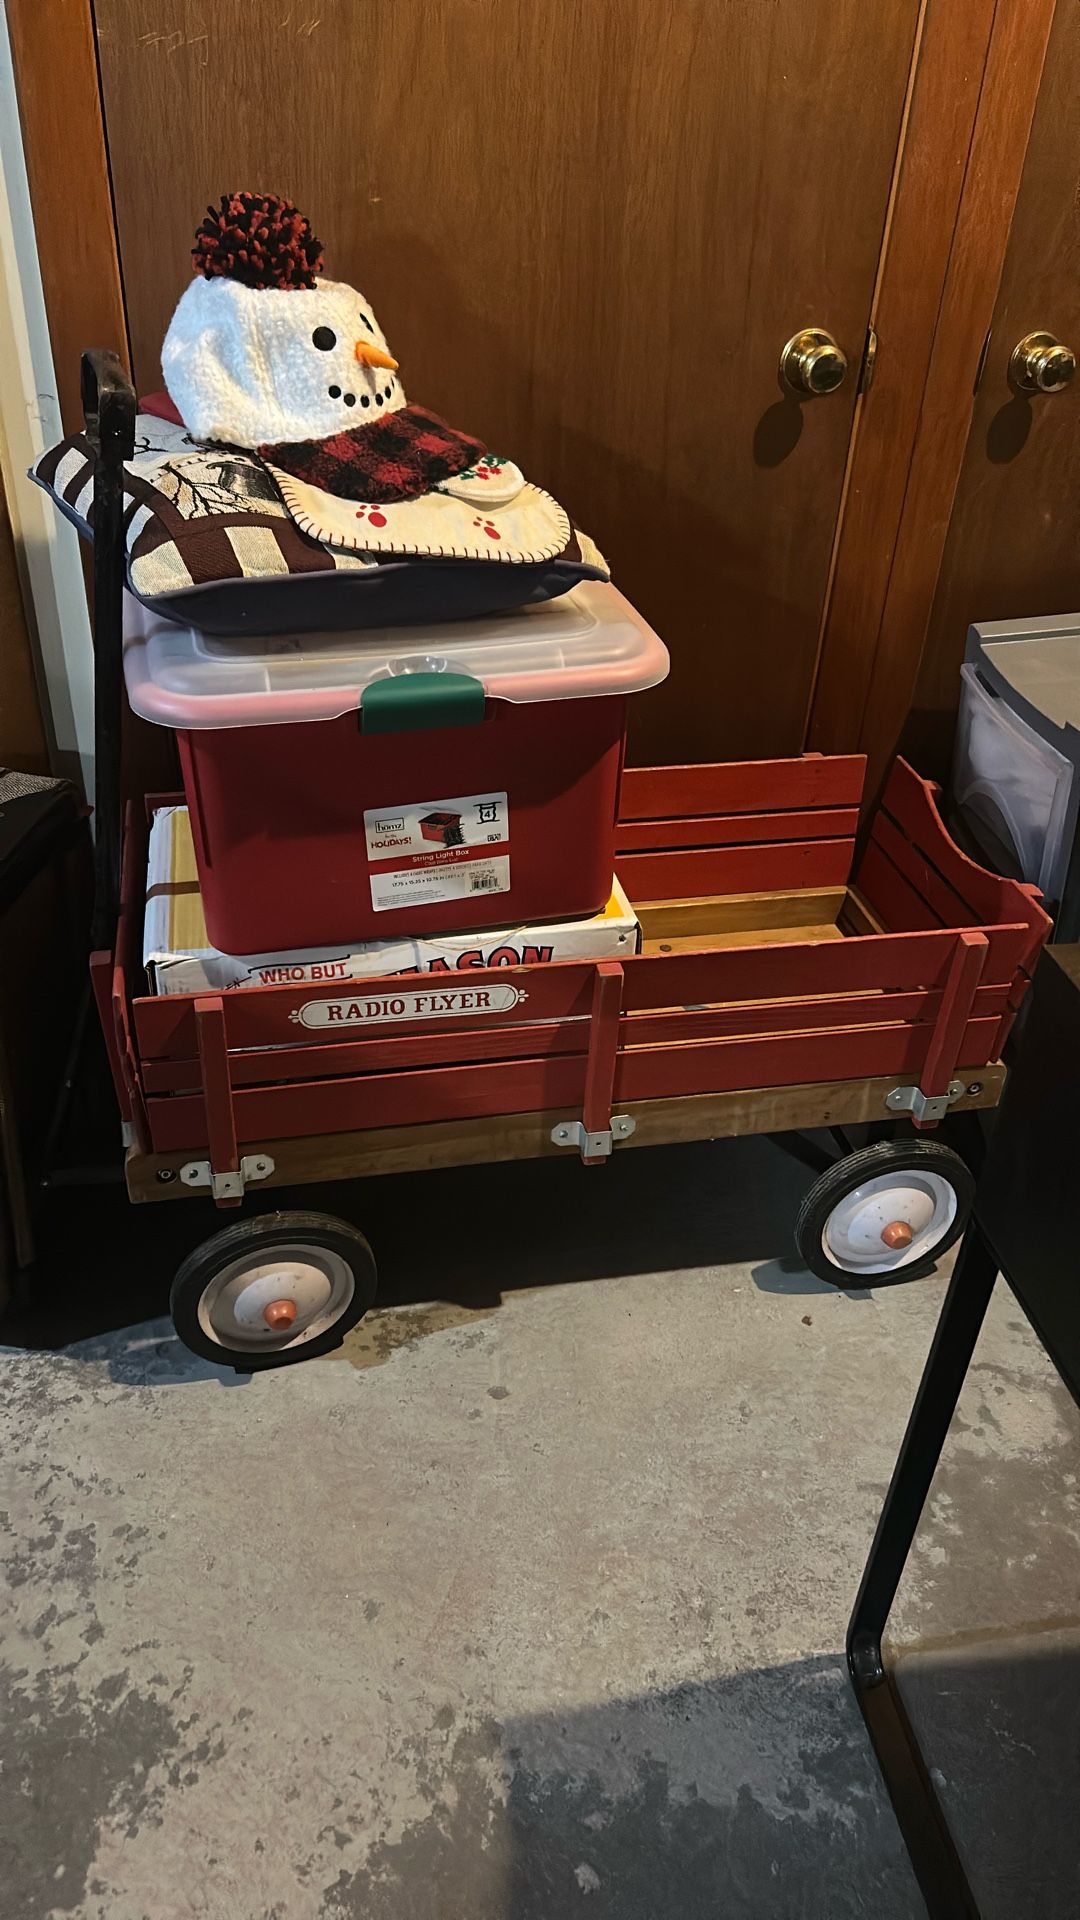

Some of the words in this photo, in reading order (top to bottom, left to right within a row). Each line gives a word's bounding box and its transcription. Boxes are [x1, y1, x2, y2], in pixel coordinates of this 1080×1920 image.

[371, 836, 412, 849] HOLIDAYS!
[412, 855, 434, 863] String
[435, 851, 454, 860] Light
[259, 967, 304, 983] WHO
[311, 962, 347, 979] BUT
[327, 999, 405, 1020] RADIO
[414, 992, 491, 1012] FLYER
